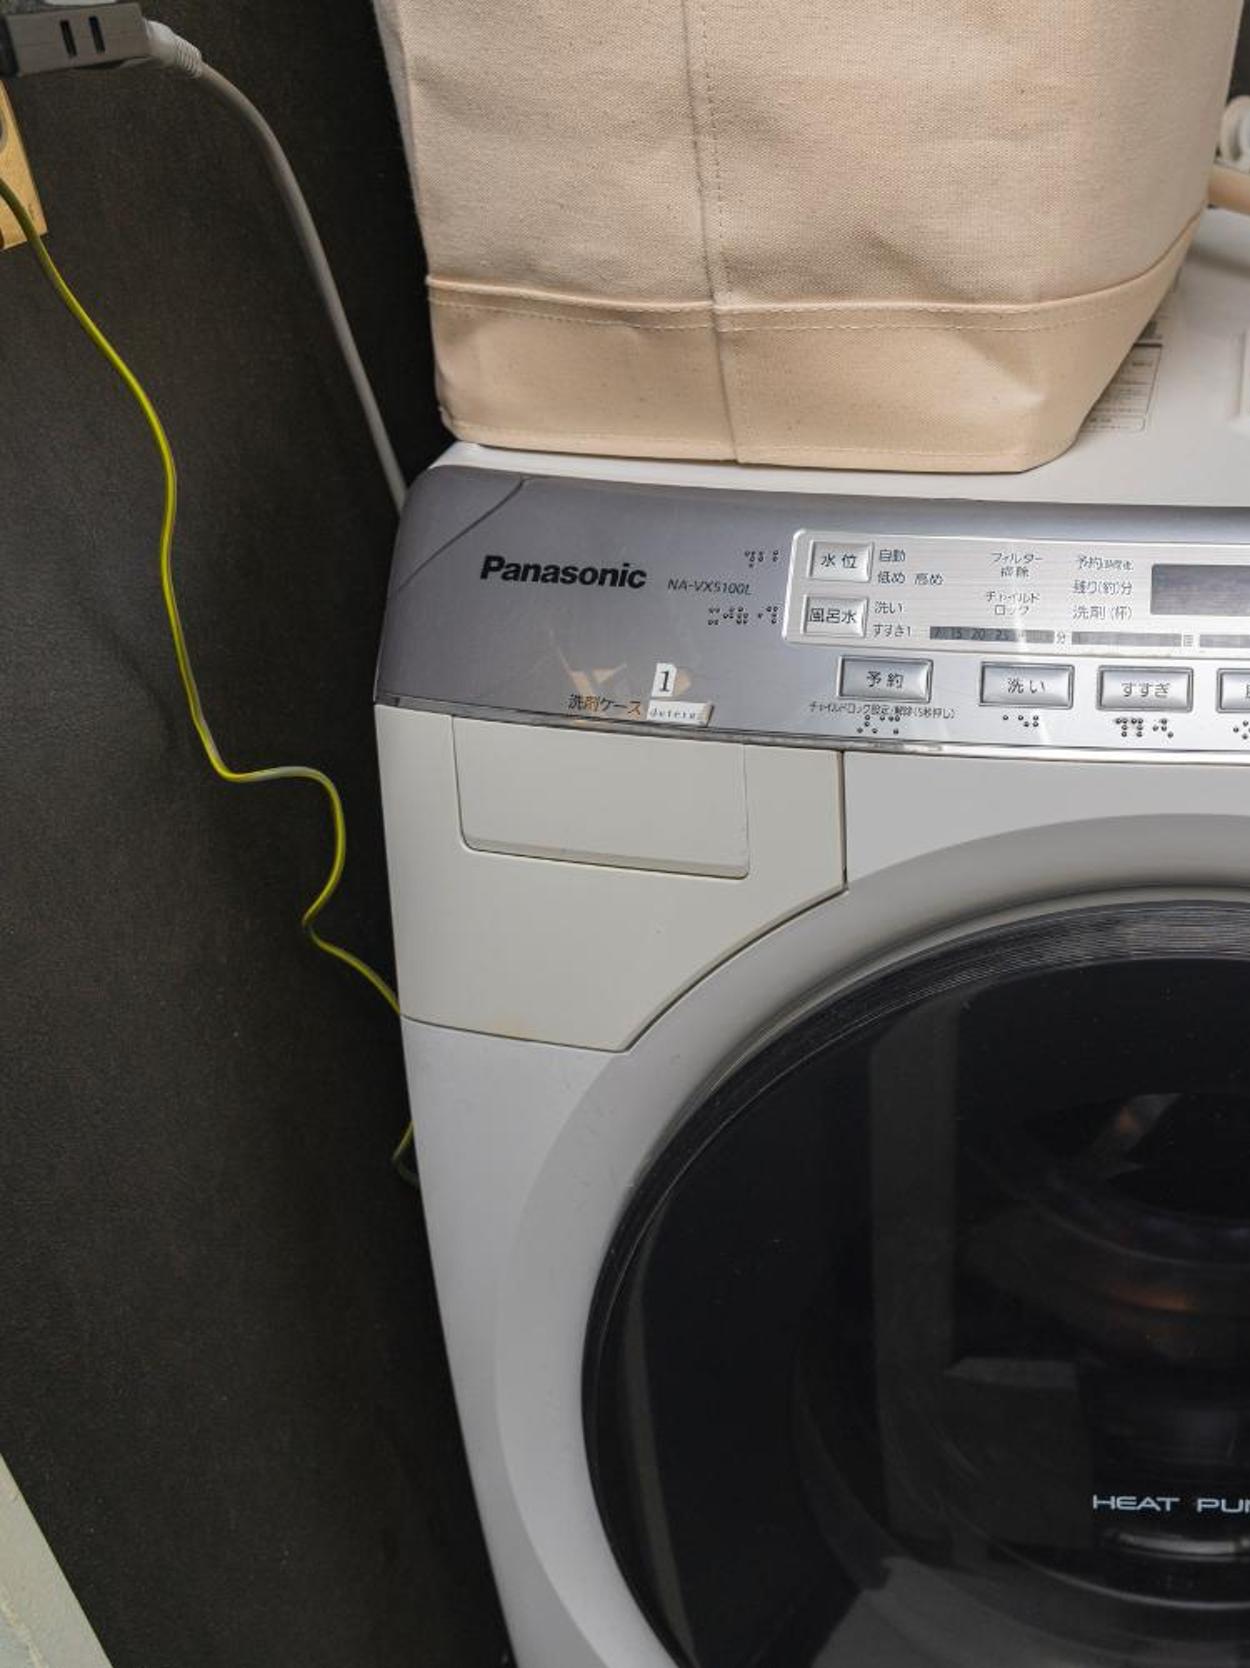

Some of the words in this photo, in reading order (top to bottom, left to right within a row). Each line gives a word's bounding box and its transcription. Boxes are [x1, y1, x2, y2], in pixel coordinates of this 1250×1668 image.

[820, 553, 858, 569] 水位
[879, 550, 906, 563] 自動
[480, 554, 647, 589] Panasonic
[808, 607, 858, 625] 風呂水
[875, 600, 903, 614] 洗い
[659, 671, 671, 692] 1
[866, 671, 905, 689] 予約
[1007, 678, 1046, 694] 洗い
[1121, 682, 1171, 698] すすぎ
[567, 693, 642, 716] 洗剤ケース
[1092, 1494, 1180, 1512] HEAT
